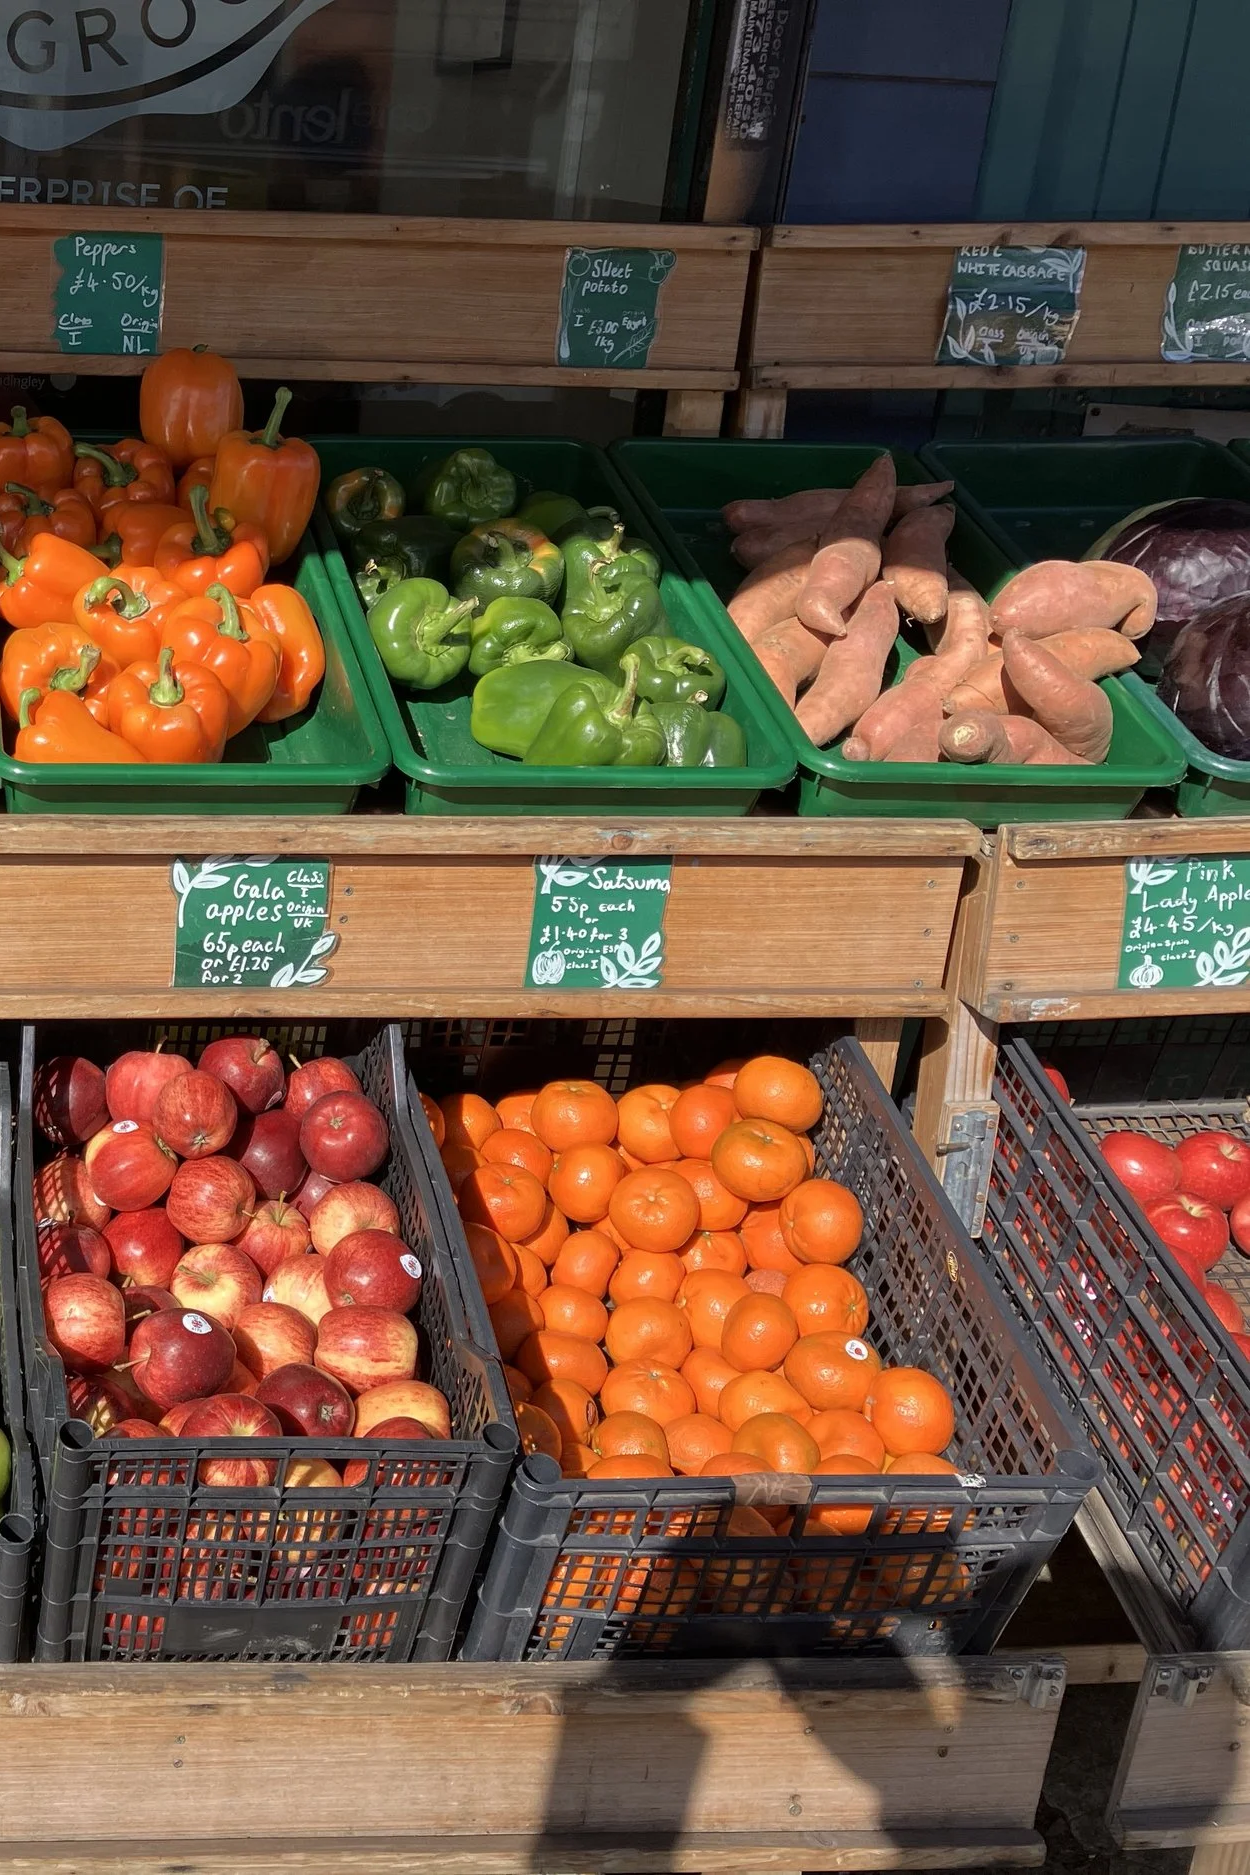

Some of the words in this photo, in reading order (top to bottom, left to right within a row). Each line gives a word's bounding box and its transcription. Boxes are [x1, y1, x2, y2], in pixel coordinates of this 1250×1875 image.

[730, 94, 746, 139] REPAIR
[174, 185, 230, 209] OF
[74, 236, 138, 268] Peppers
[959, 245, 990, 257] RED
[957, 261, 1001, 276] WHITE
[1002, 264, 1067, 283] CABBAGE
[1202, 259, 1250, 272] SQUAS
[581, 280, 629, 296] potato
[587, 319, 620, 336] £3.00
[121, 335, 151, 355] NL
[1186, 857, 1236, 883] Pink
[233, 873, 286, 900] Gala
[588, 867, 671, 895] Satsuma
[286, 899, 325, 915] Origin
[598, 898, 635, 913] each
[1142, 886, 1198, 915] Lady
[206, 900, 284, 927] apples
[584, 917, 600, 925] or
[539, 924, 588, 945] £1.40
[590, 926, 614, 943] for
[618, 927, 629, 940] 3
[202, 931, 239, 962] 65p
[241, 931, 286, 954] each
[201, 958, 224, 970] or
[229, 955, 273, 973] £1.25
[233, 973, 244, 985] 2
